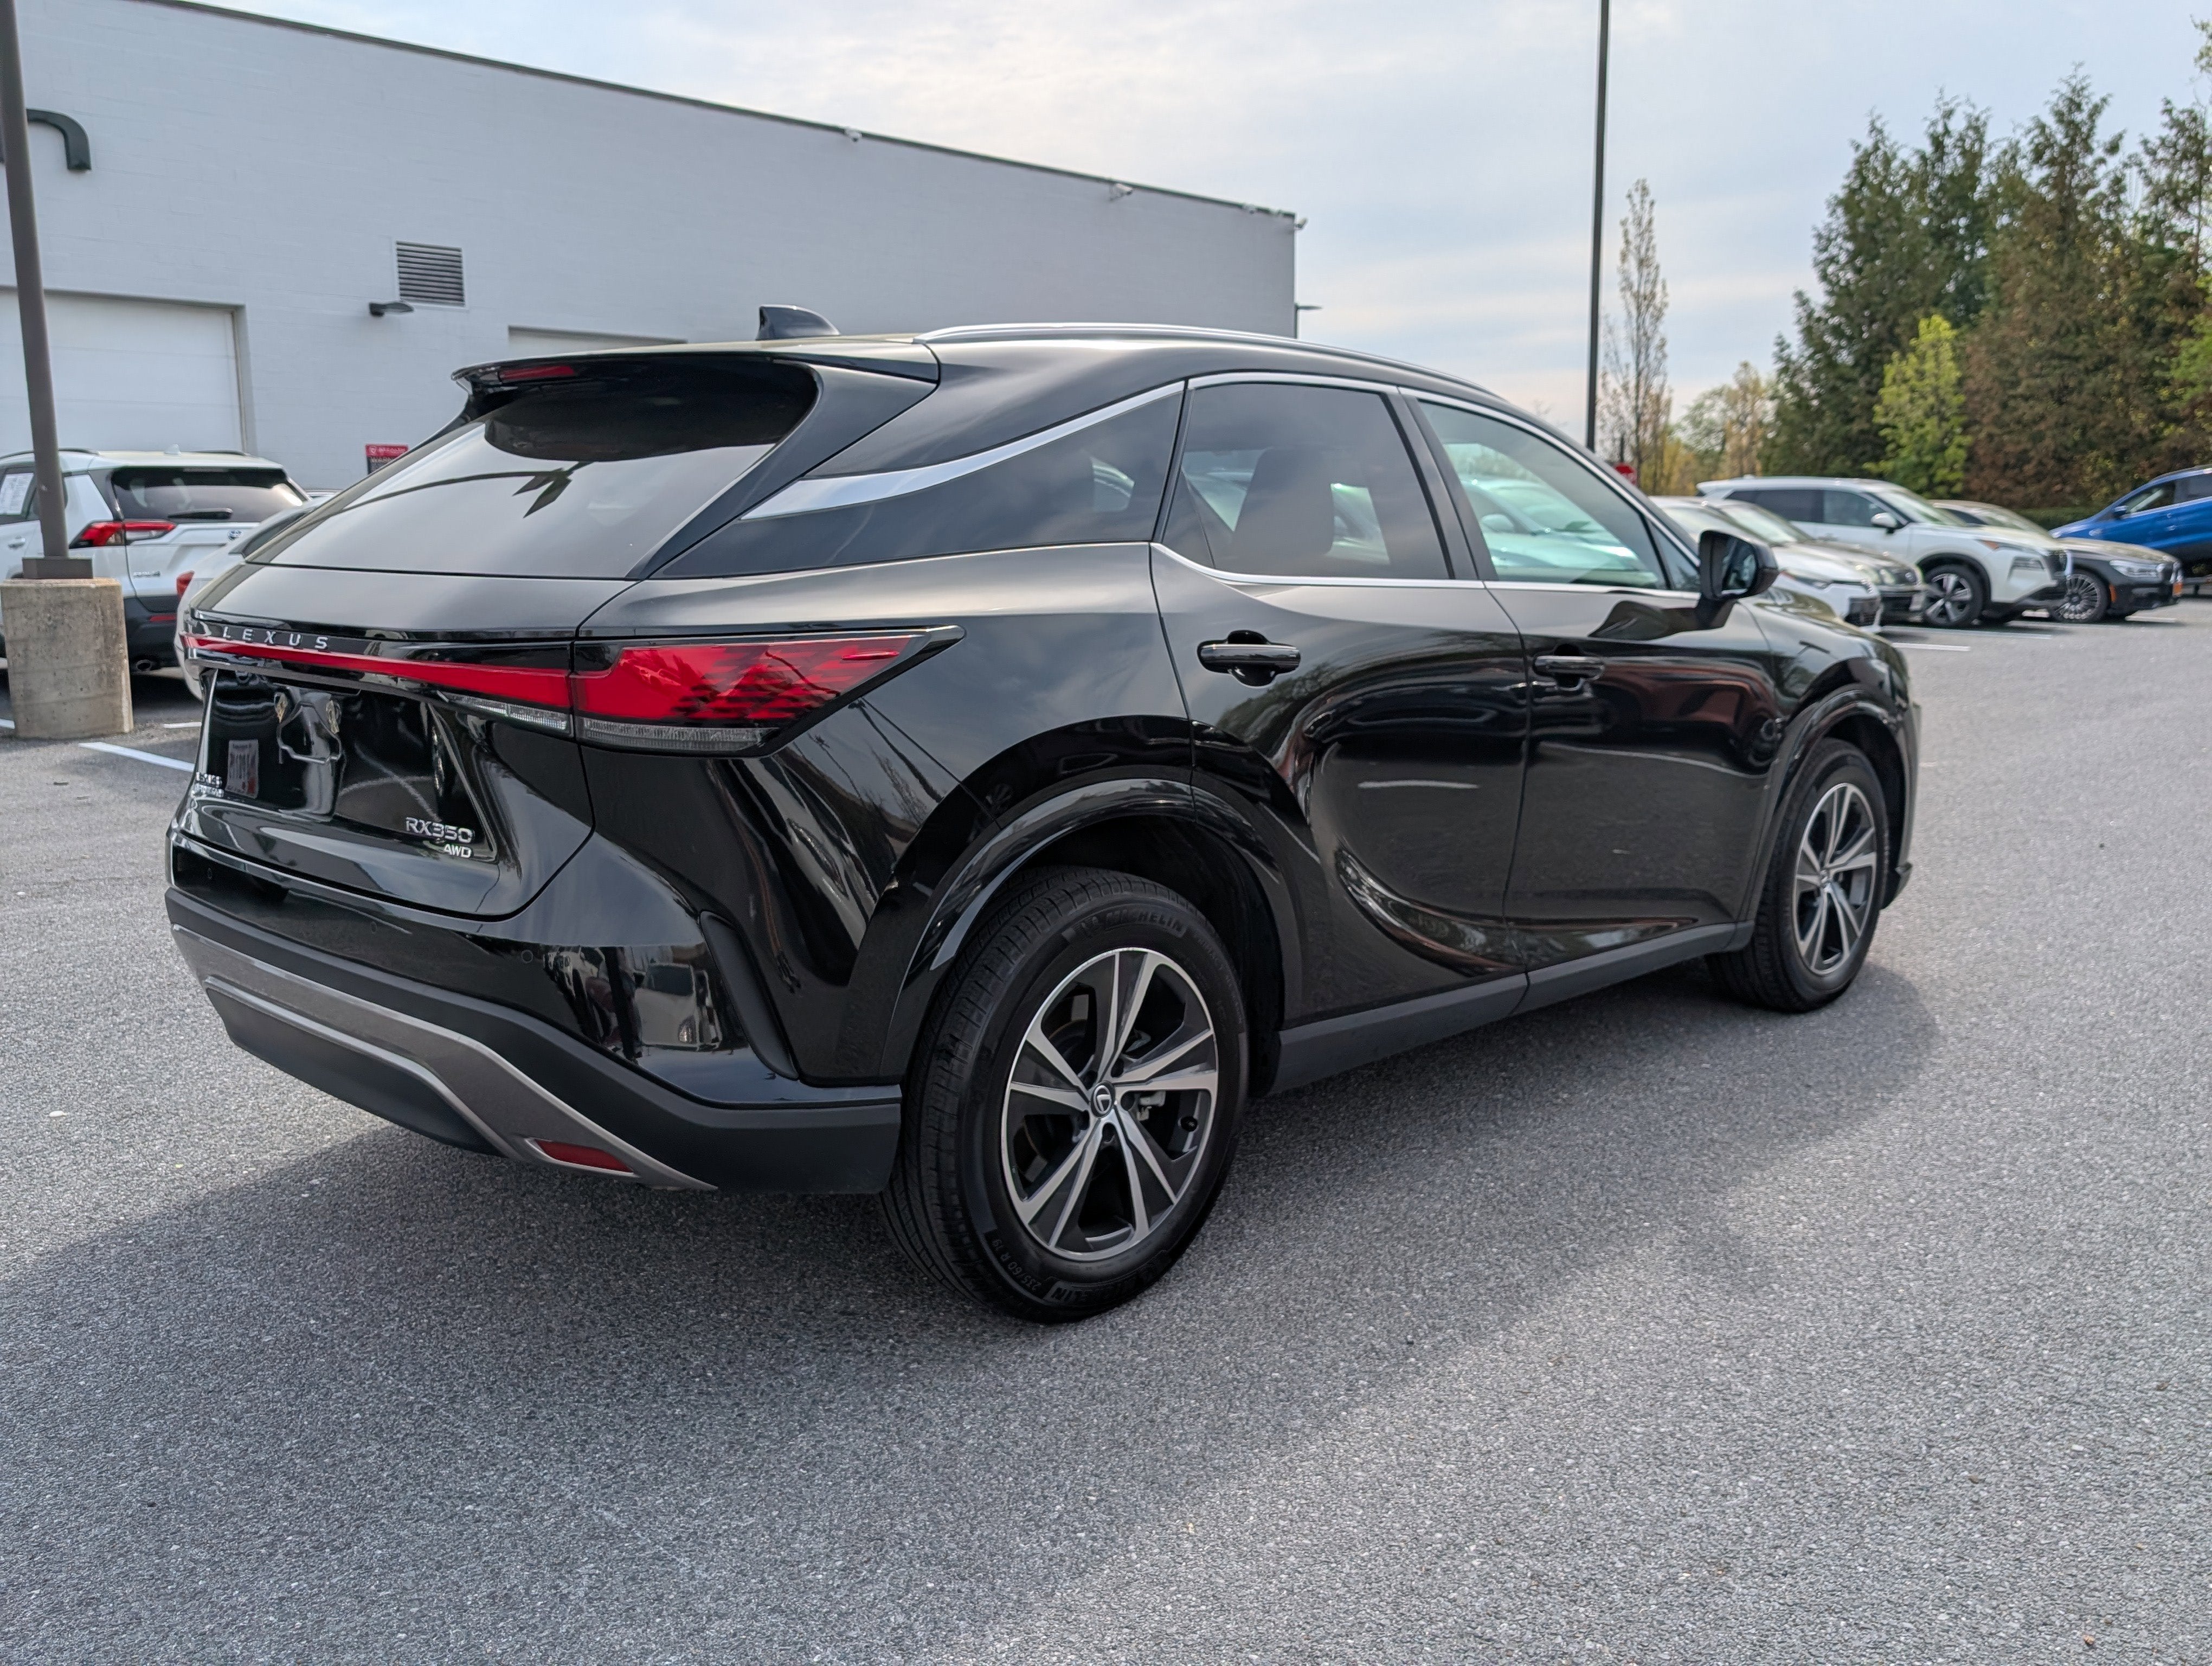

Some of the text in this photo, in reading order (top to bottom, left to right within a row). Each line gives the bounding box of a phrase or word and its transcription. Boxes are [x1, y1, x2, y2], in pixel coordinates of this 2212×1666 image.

[222, 626, 329, 650] LEXUS
[406, 817, 473, 843] RX350
[443, 843, 472, 858] AWD
[1106, 909, 1185, 933] MICHELIN
